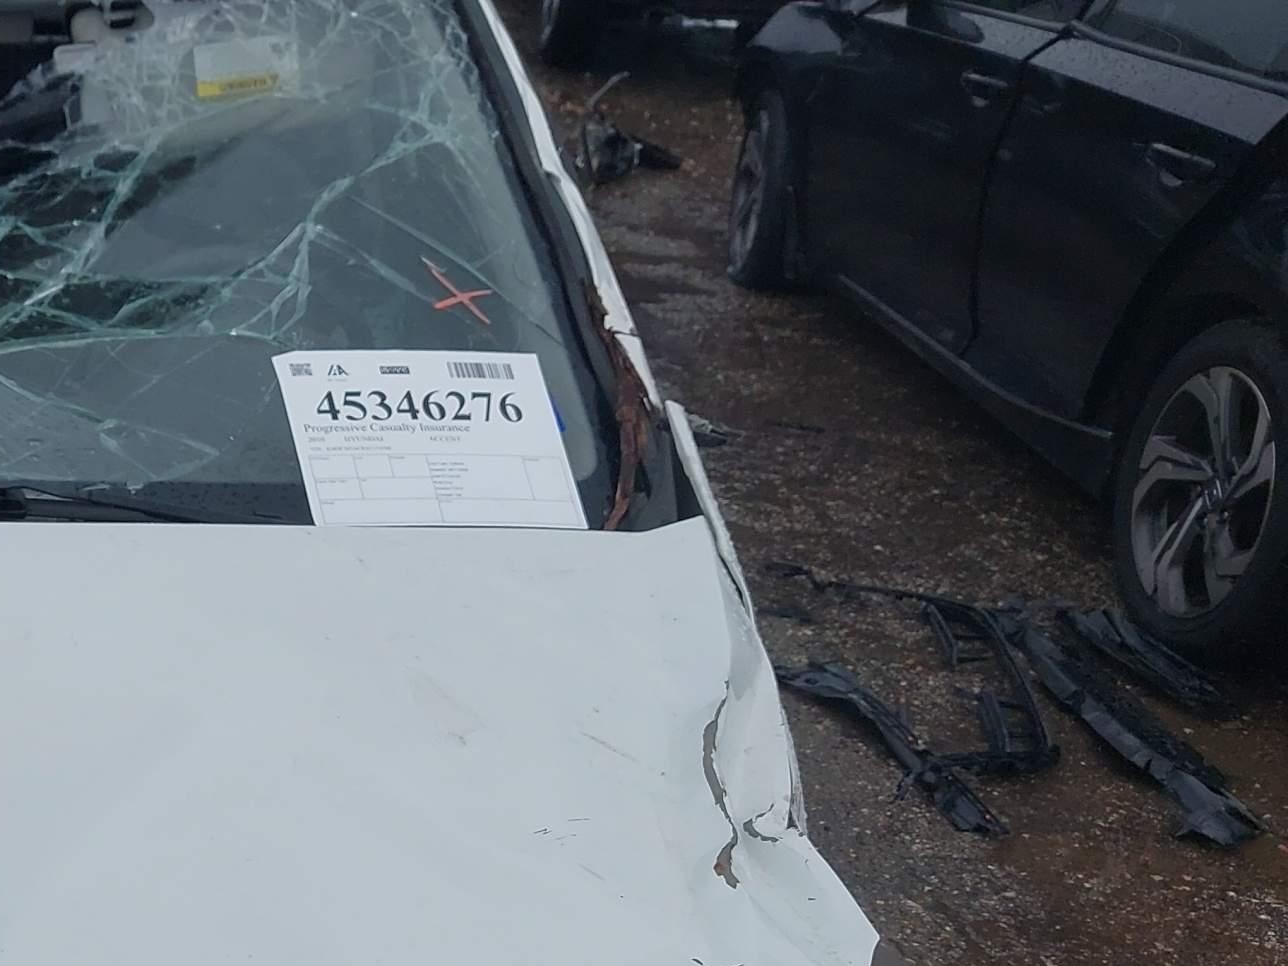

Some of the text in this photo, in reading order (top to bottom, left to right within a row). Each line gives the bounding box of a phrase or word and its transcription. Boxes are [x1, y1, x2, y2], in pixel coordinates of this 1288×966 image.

[316, 389, 523, 423] 45346276
[303, 423, 471, 434] Progressive Casualty Insurance
